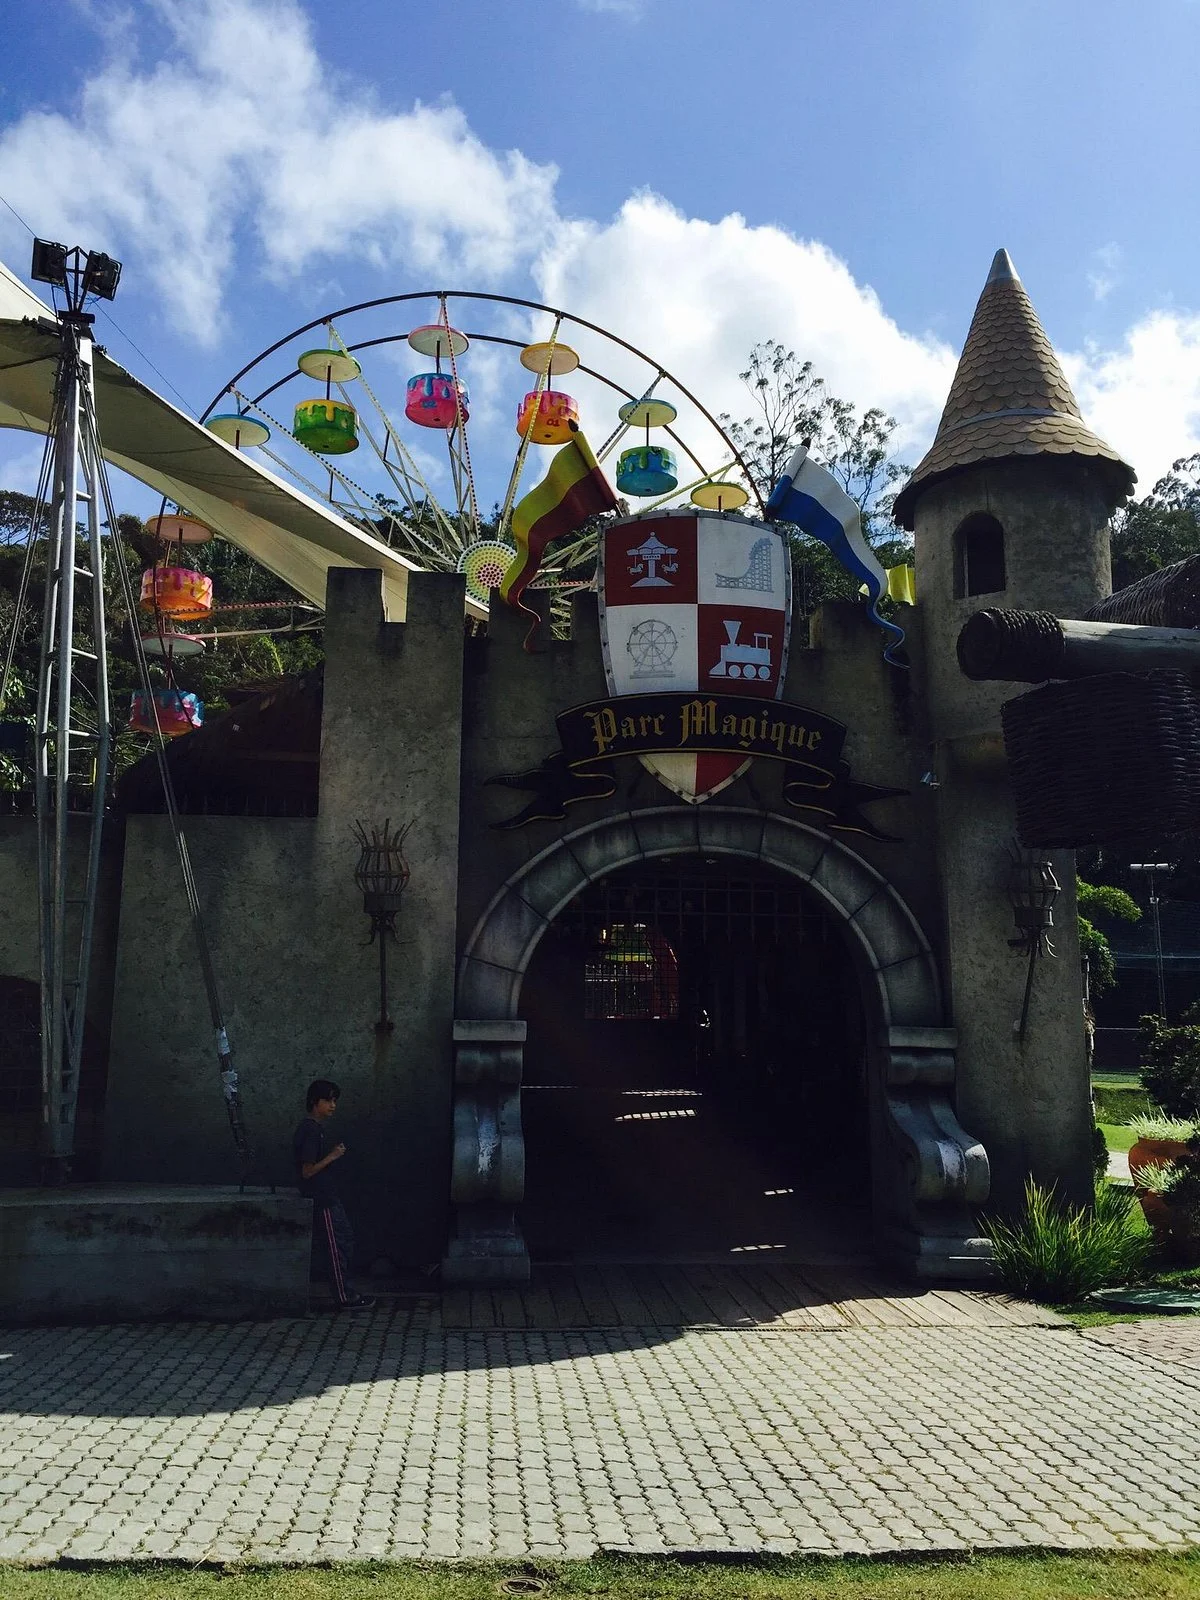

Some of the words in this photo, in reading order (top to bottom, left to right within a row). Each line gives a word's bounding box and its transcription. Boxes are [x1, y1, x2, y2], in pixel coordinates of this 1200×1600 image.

[546, 418, 560, 427] 01
[583, 706, 665, 754] Parc
[677, 699, 822, 752] Magique
